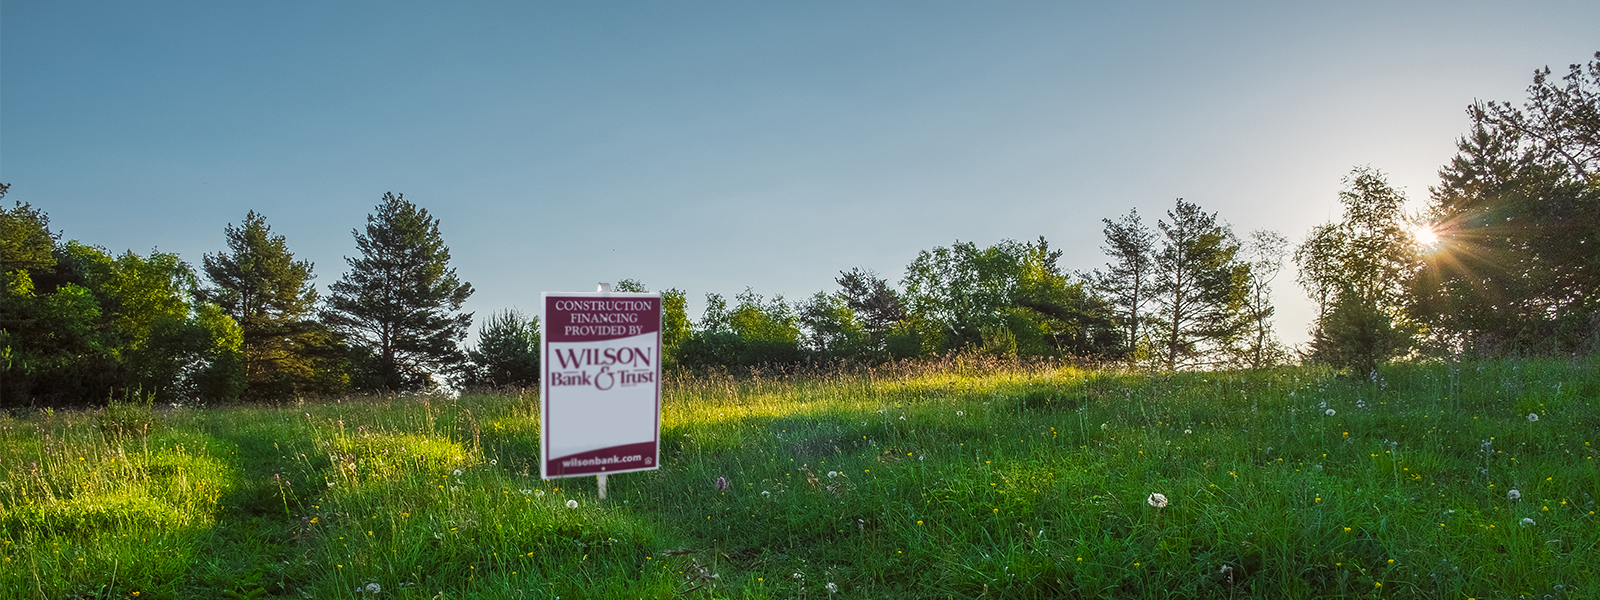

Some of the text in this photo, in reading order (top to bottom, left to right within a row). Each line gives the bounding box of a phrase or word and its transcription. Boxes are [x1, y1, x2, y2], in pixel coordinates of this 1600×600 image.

[555, 300, 652, 311] CONSTRUCTION
[570, 313, 638, 323] FINANCING
[564, 325, 643, 336] PROVIDED BY
[555, 346, 651, 370] WILSON
[551, 365, 654, 391] Bank & Trust
[562, 454, 642, 468] wilsonbank.com
